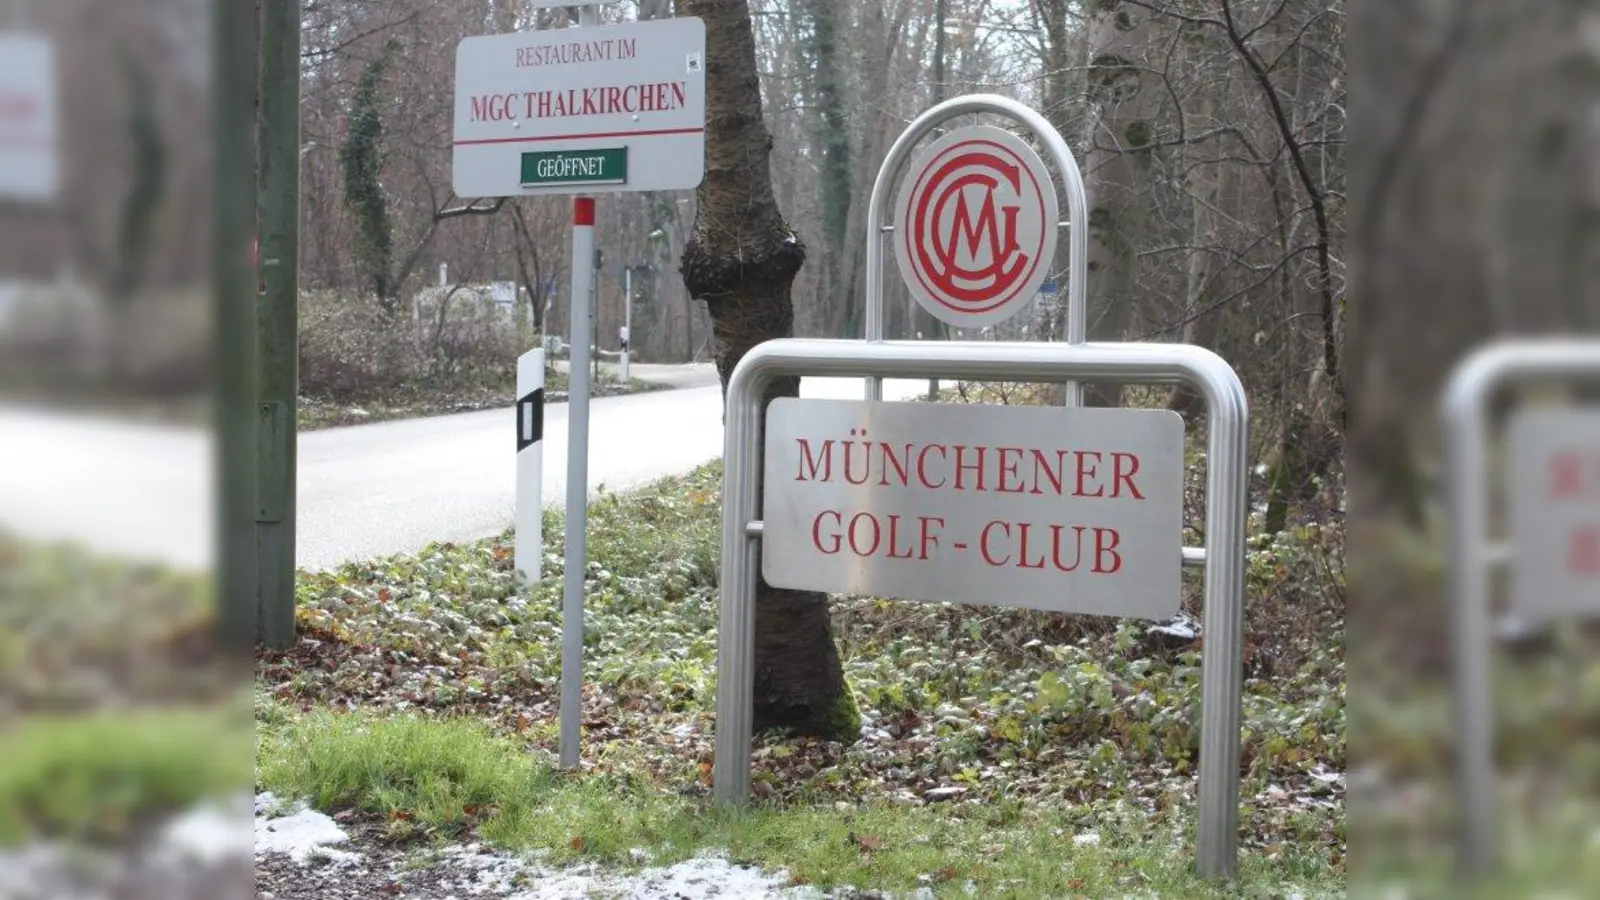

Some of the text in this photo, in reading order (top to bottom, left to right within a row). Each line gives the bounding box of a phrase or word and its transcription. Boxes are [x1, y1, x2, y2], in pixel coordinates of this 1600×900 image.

[516, 38, 636, 67] RESTAURANT IM
[470, 81, 686, 122] MGC THALKIRCHEN
[537, 155, 604, 178] GEÖFFNET
[795, 428, 1146, 500] MÜNCHENER
